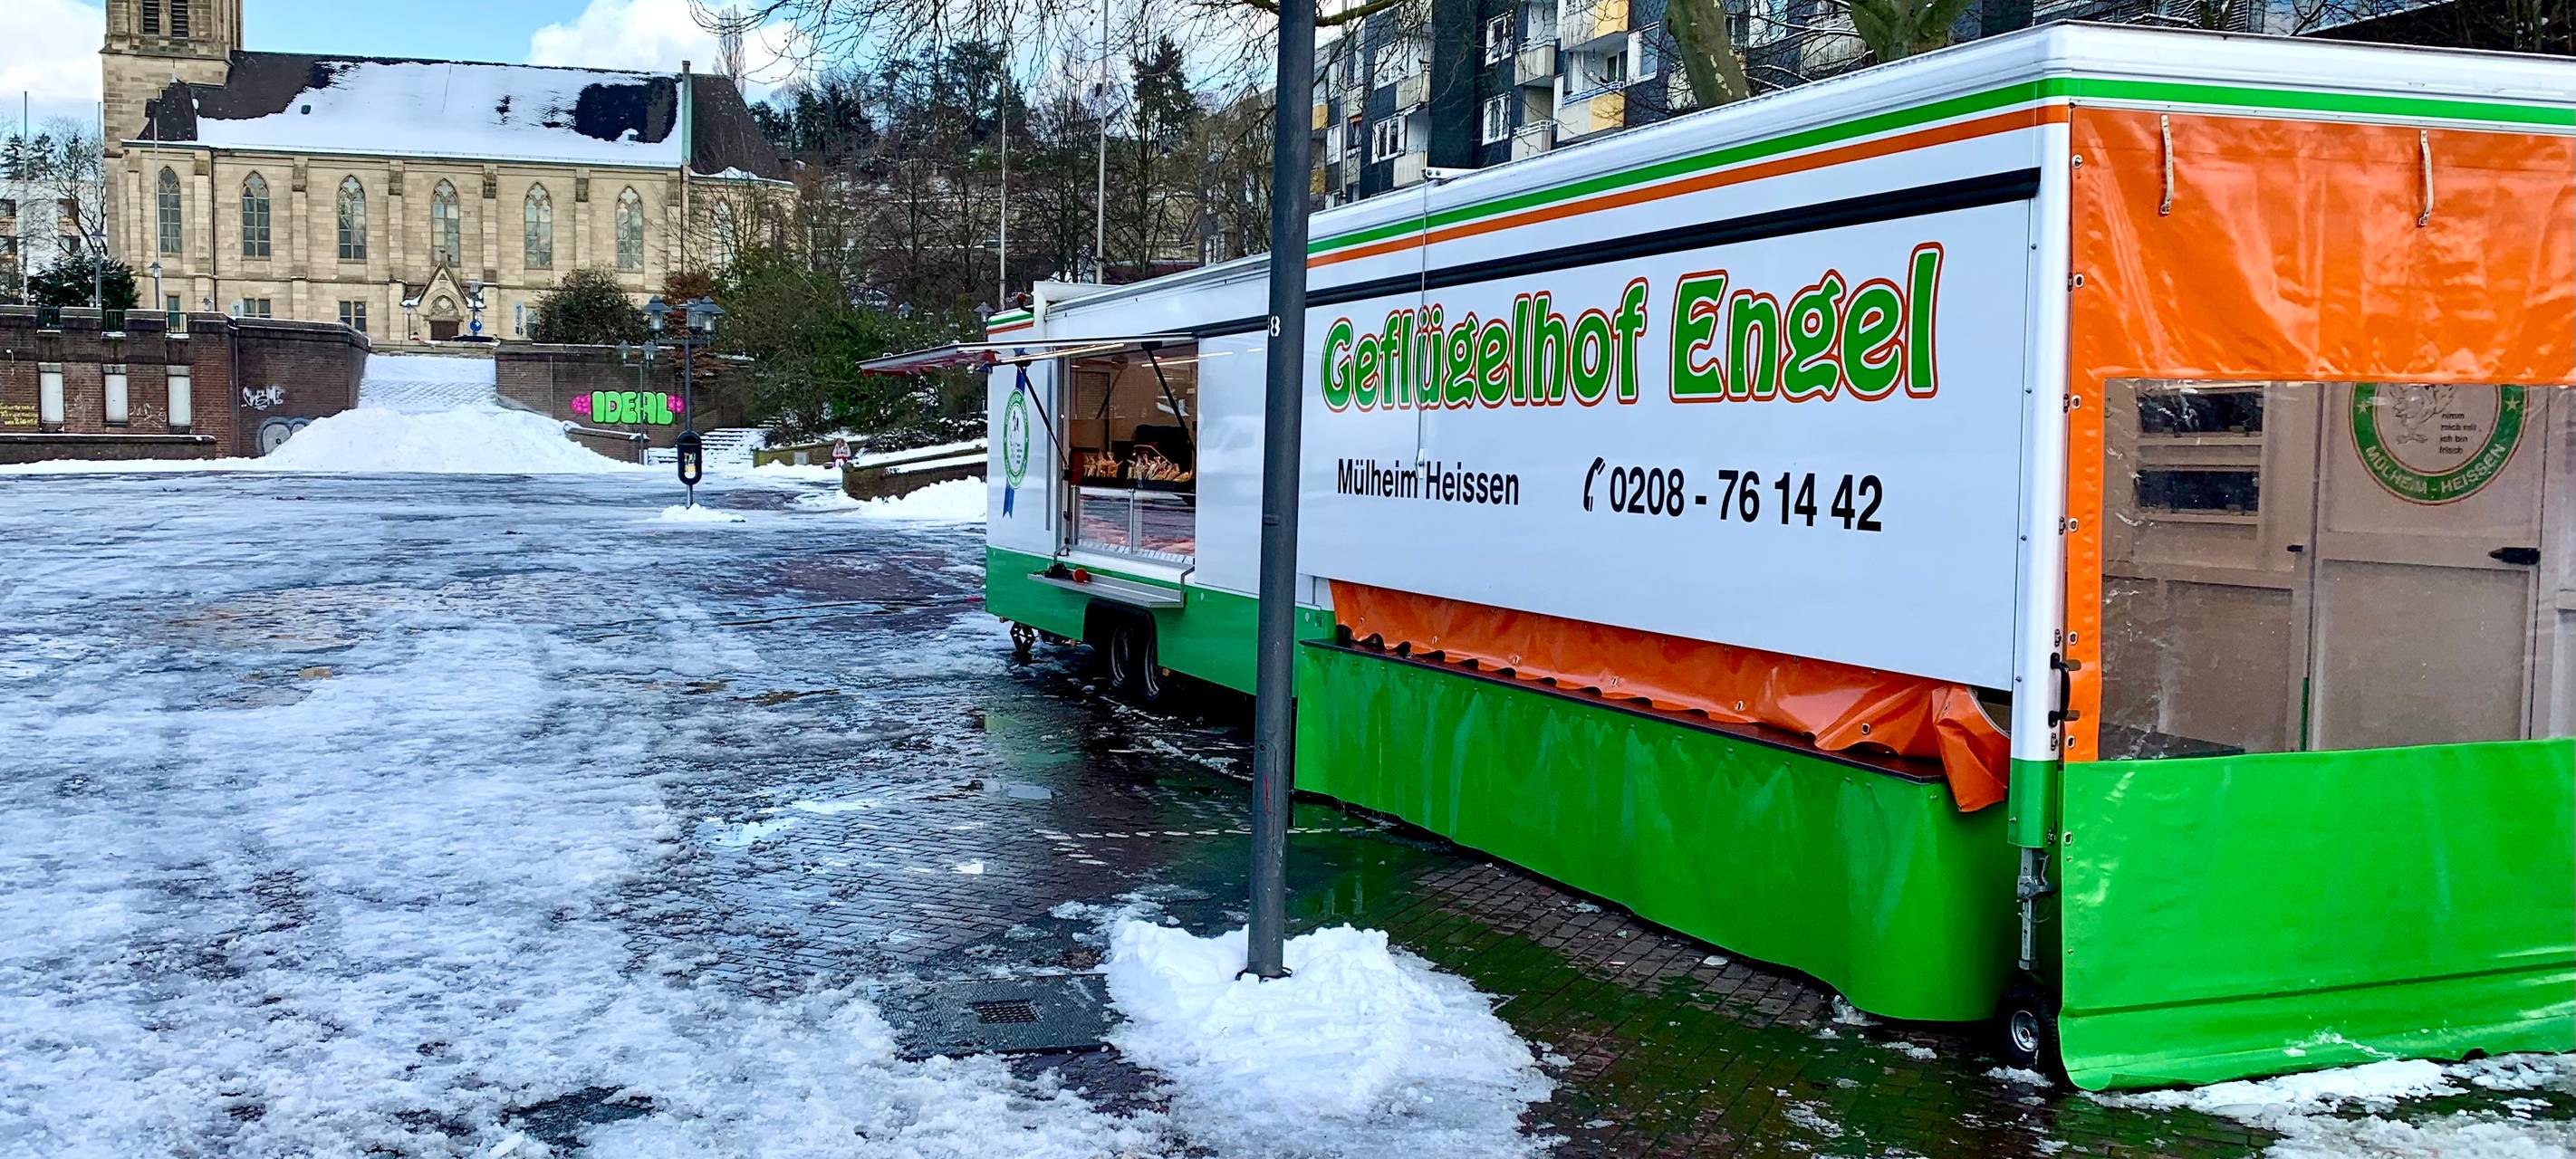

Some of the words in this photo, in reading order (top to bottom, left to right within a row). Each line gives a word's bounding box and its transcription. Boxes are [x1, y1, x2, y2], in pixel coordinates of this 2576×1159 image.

[1270, 315, 1281, 338] 8
[1321, 276, 1649, 412] Geflügelhof
[1669, 242, 1945, 403] Engel
[591, 390, 675, 426] IDEAL
[1337, 458, 1418, 499] Mülheim
[1425, 460, 1520, 506] Heissen
[2440, 443, 2506, 493] HEISSEN
[1610, 465, 1685, 517] 0208
[1695, 495, 1707, 505] -
[1718, 469, 1761, 523] 76
[1774, 472, 1818, 527] 14
[1831, 474, 1883, 532] 42
